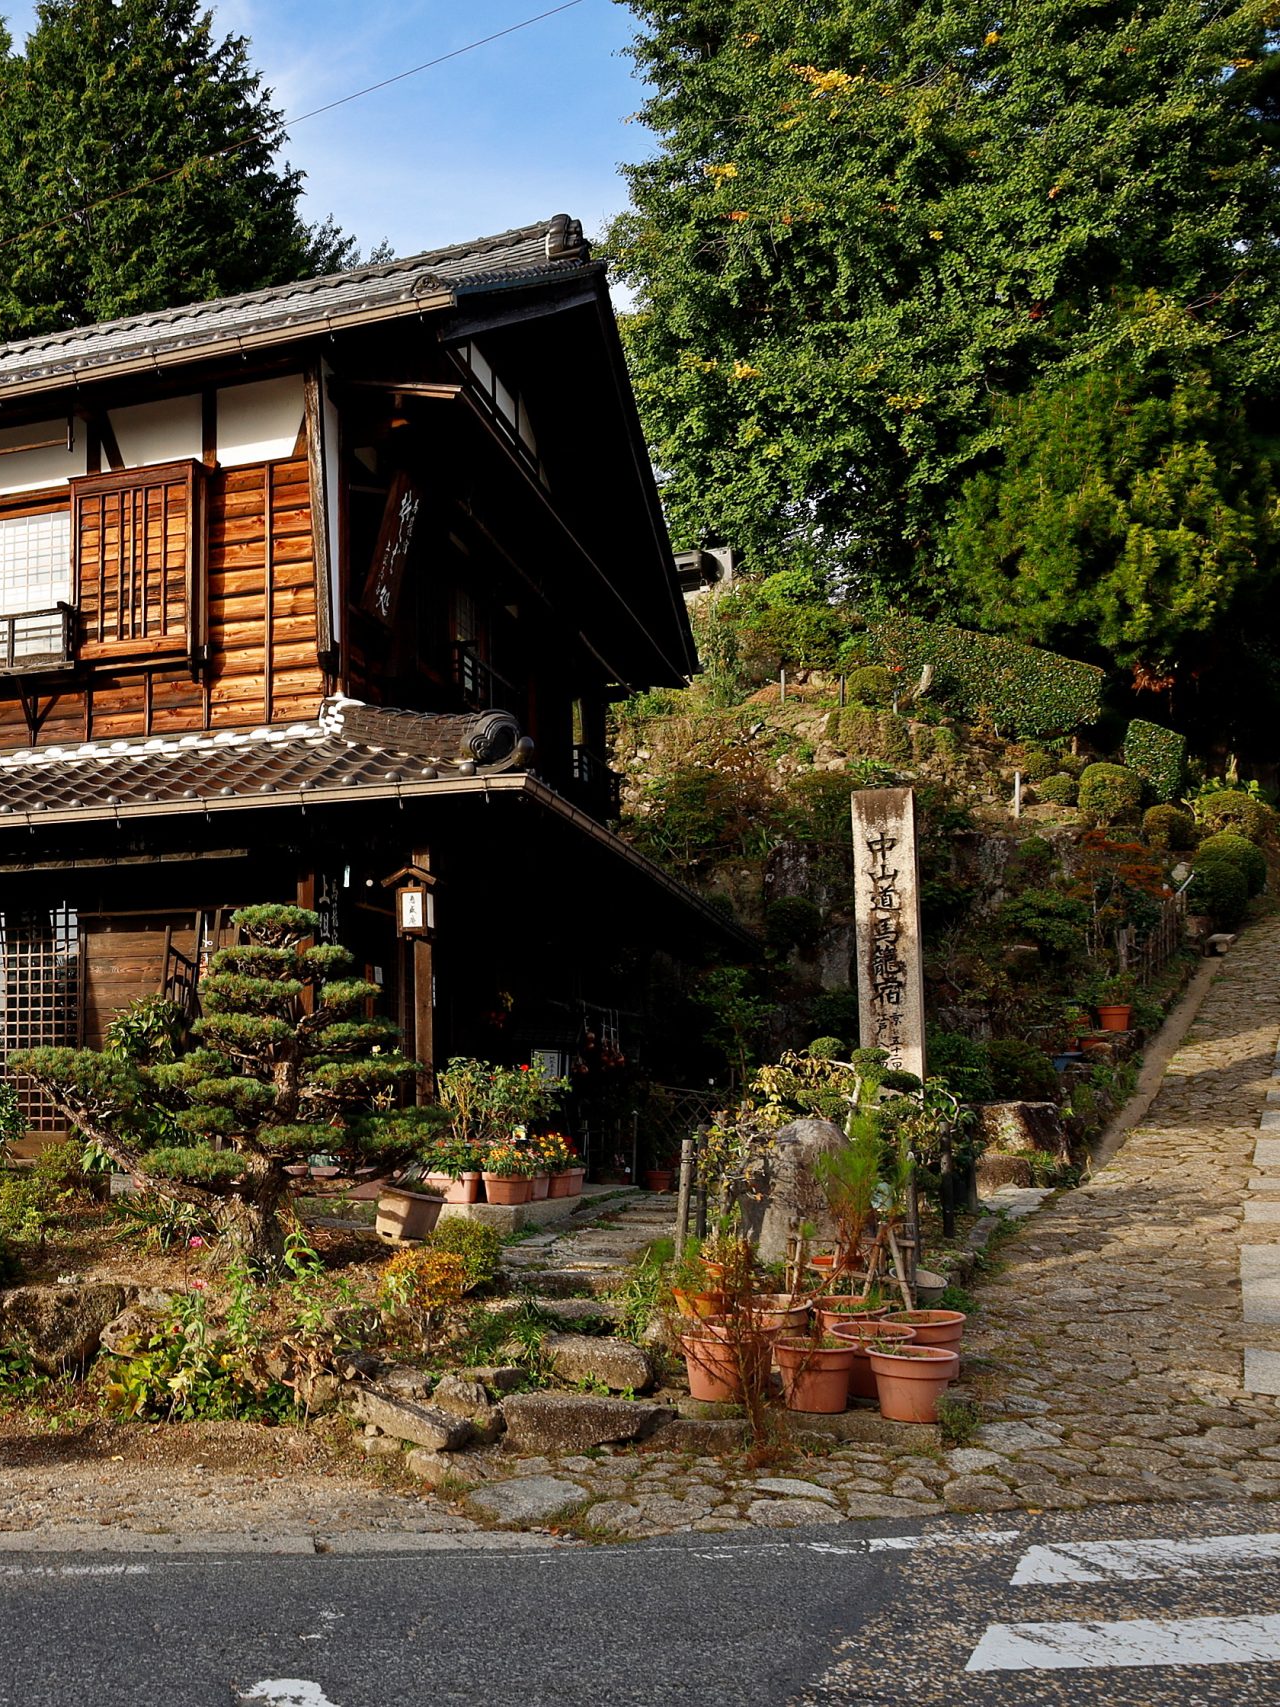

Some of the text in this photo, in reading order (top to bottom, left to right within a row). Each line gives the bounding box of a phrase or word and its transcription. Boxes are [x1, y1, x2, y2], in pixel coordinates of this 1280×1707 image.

[866, 832, 903, 1006] 中山道馬籠宿
